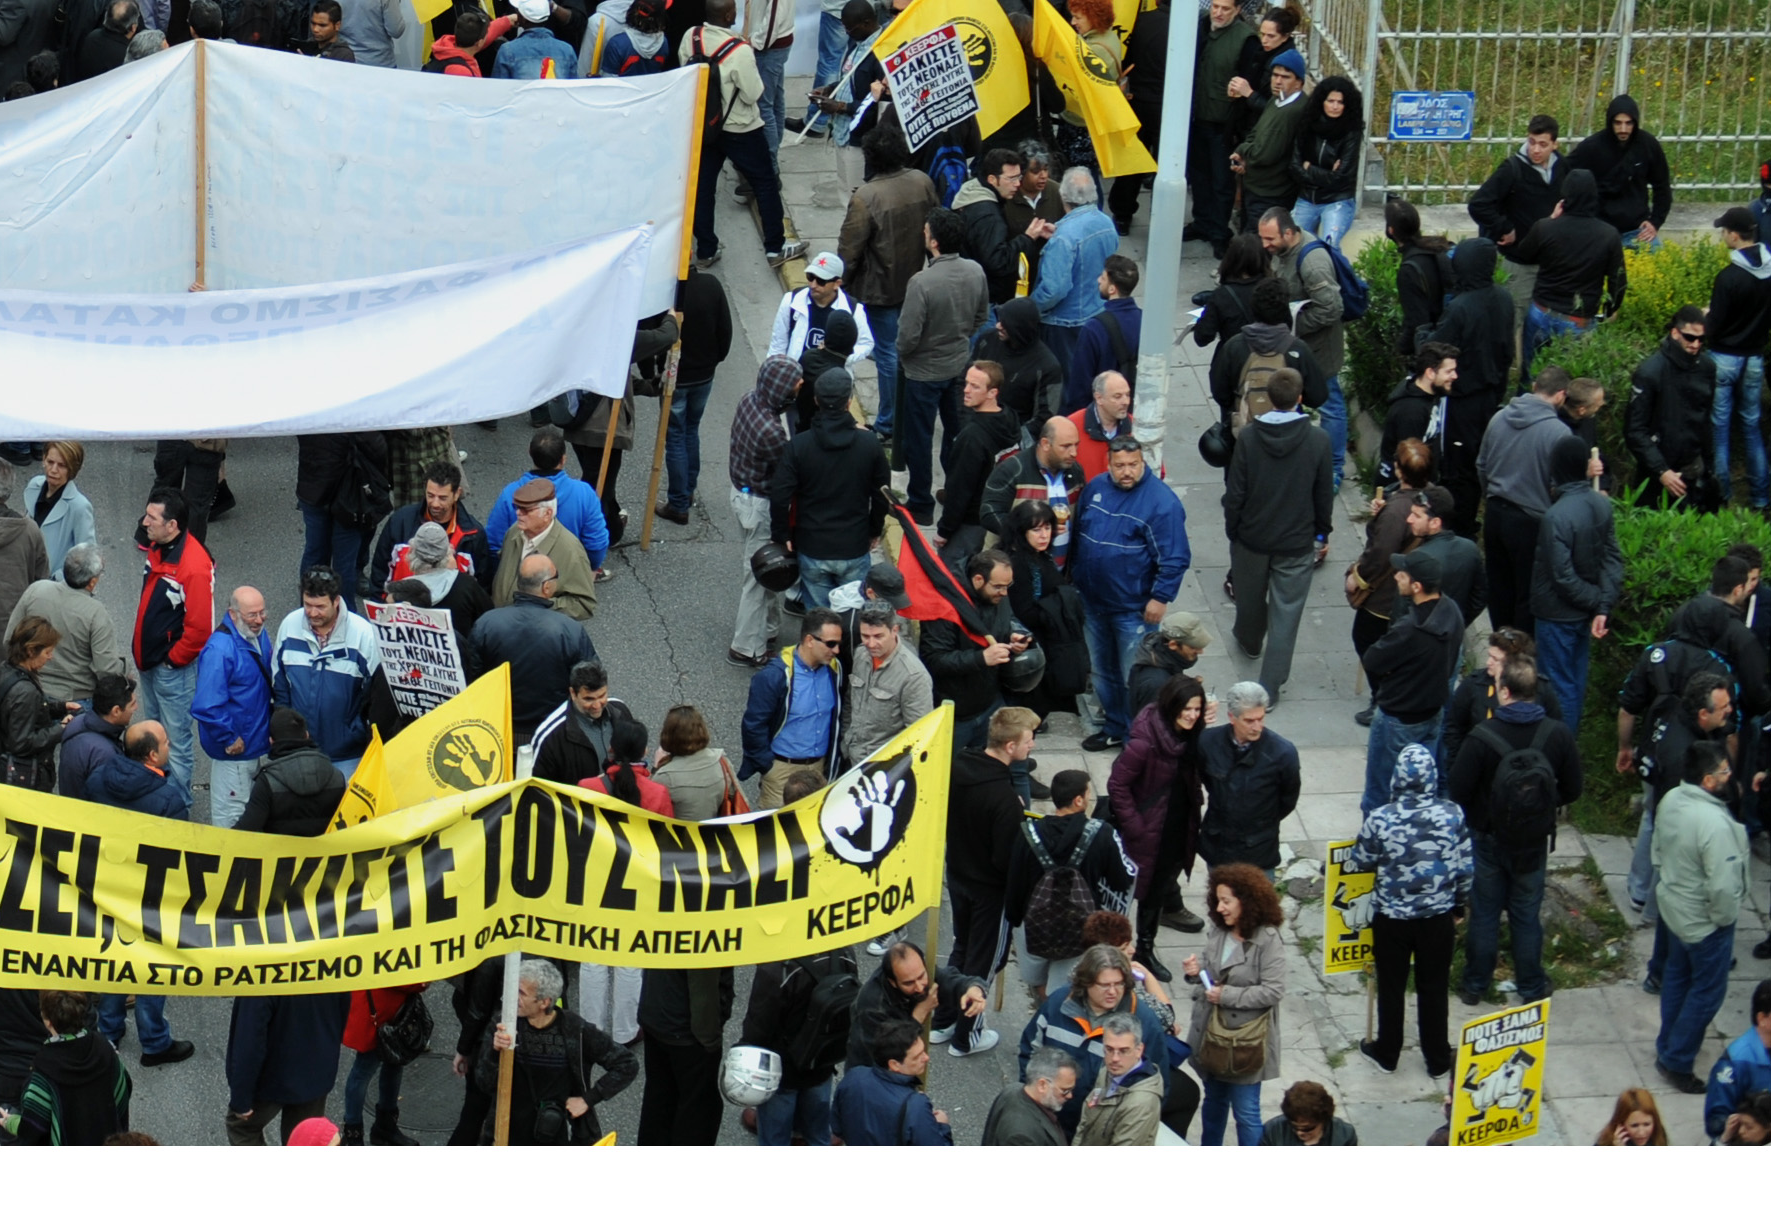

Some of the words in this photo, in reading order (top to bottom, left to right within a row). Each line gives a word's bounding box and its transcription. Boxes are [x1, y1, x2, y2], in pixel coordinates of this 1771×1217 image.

[904, 31, 947, 58] ΚΕΕΡΦΑ
[892, 40, 959, 86] ΤΣΑΚΙΣΤΕ
[897, 83, 916, 100] ΤΟΥΣ
[914, 53, 963, 87] ΝΕΟΝΑΖΙ
[941, 65, 966, 85] ΑΥΓΗΣ
[931, 76, 969, 102] ΓΕΙΤΟΝΙΑ
[908, 112, 928, 134] ΟΥΤΕ
[911, 123, 933, 145] ΟΥΤΕ
[932, 98, 976, 126] ΠΟΥΘΕΝΑ
[377, 624, 452, 651] ΤΣΑΚΙΣΤΕ
[380, 646, 404, 659] ΤΟΥΣ
[404, 645, 456, 669] ΝΕΟΝΑΖΙ
[424, 679, 461, 696] ΓΕΙΤΟΝΙΑ
[433, 668, 459, 682] ΑΥΓΗΣ
[393, 690, 419, 705] ΟΥΤΕ
[136, 829, 458, 950] ΤΣΑΚΙΣΤΕ
[471, 785, 637, 911] ΤΟΥΣ
[648, 810, 811, 913] ΝΑΖΙ
[1333, 847, 1351, 863] ΠΟ
[806, 876, 915, 940] ΚΕΕΡΦΑ
[1, 949, 136, 983] ΕΝΑΝΤΙΑ
[147, 962, 204, 987] ΣΤΟ
[214, 954, 363, 987] ΡΑΤΣΙΣΜΟ
[373, 945, 422, 975] ΚΑΙ
[430, 934, 465, 966] ΤΗ
[474, 913, 620, 952] ΦΑΣΙΣΤΙΚΗ
[629, 926, 743, 954] ΑΠΕΙΛΗ
[1331, 944, 1372, 963] ΚΕΕΡ
[1464, 1022, 1500, 1044] ΠΟΤΕ
[1502, 1007, 1539, 1030] ΞΑΝΑ
[1474, 1024, 1543, 1053] ΦΑΣΙΣΜΟΣ
[1457, 1115, 1520, 1146] ΚΕΕΡΦΑ
